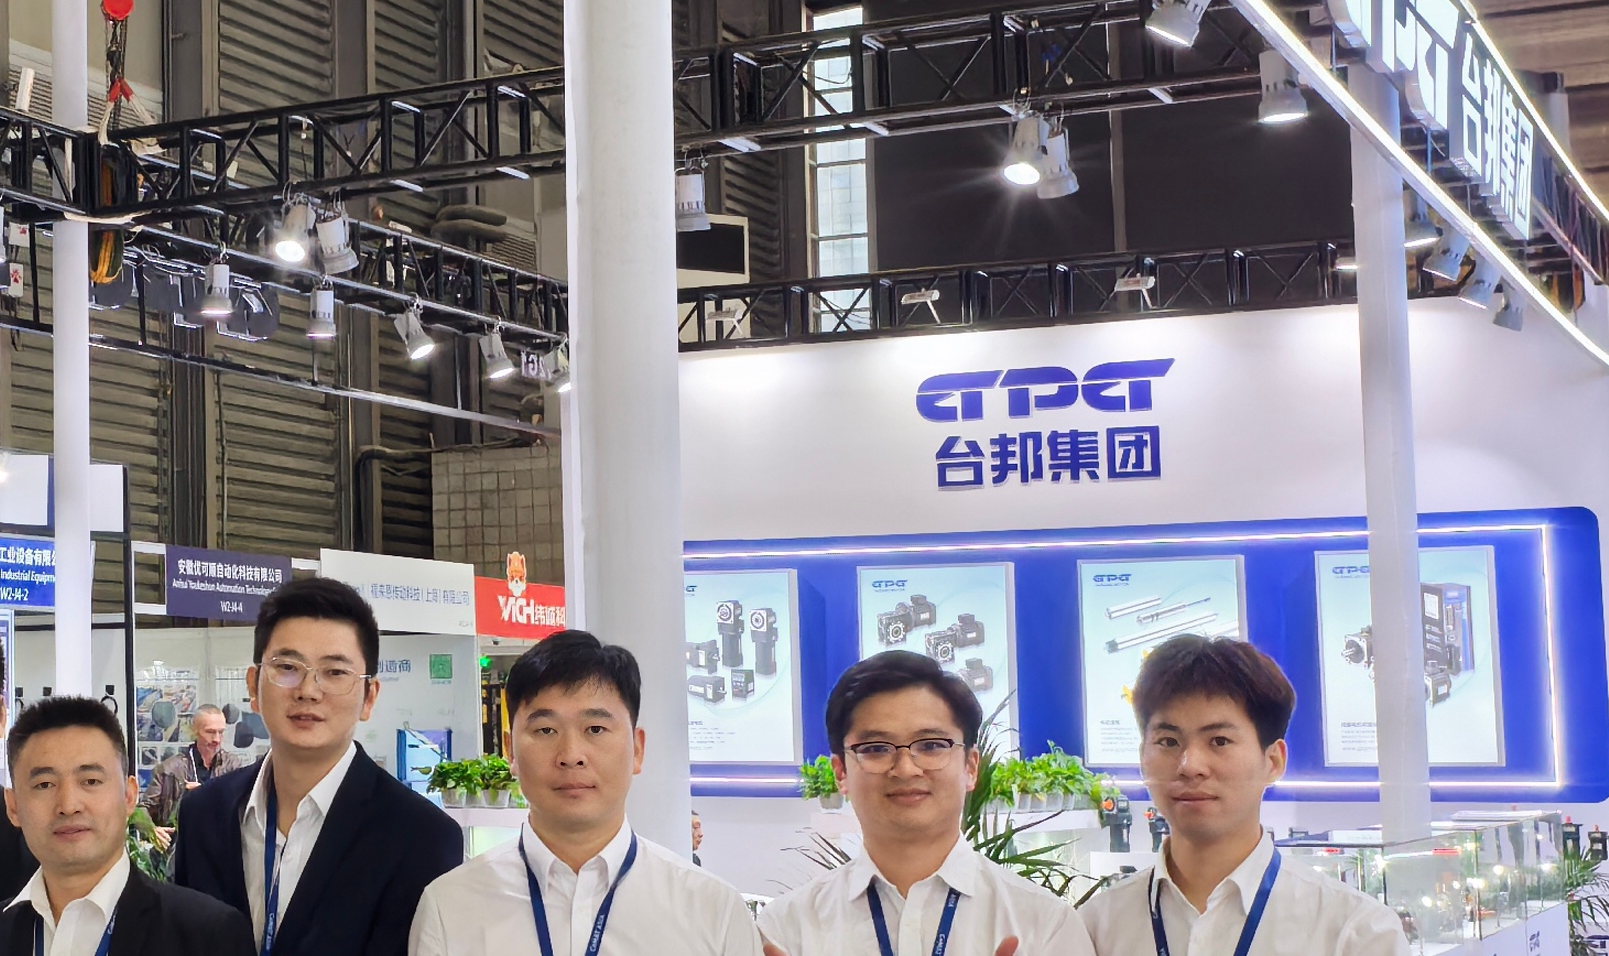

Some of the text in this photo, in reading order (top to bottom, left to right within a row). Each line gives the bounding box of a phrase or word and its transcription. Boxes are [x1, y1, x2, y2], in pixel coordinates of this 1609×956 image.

[1462, 32, 1533, 240] 台邦集团
[935, 425, 1162, 490] 台邦集团
